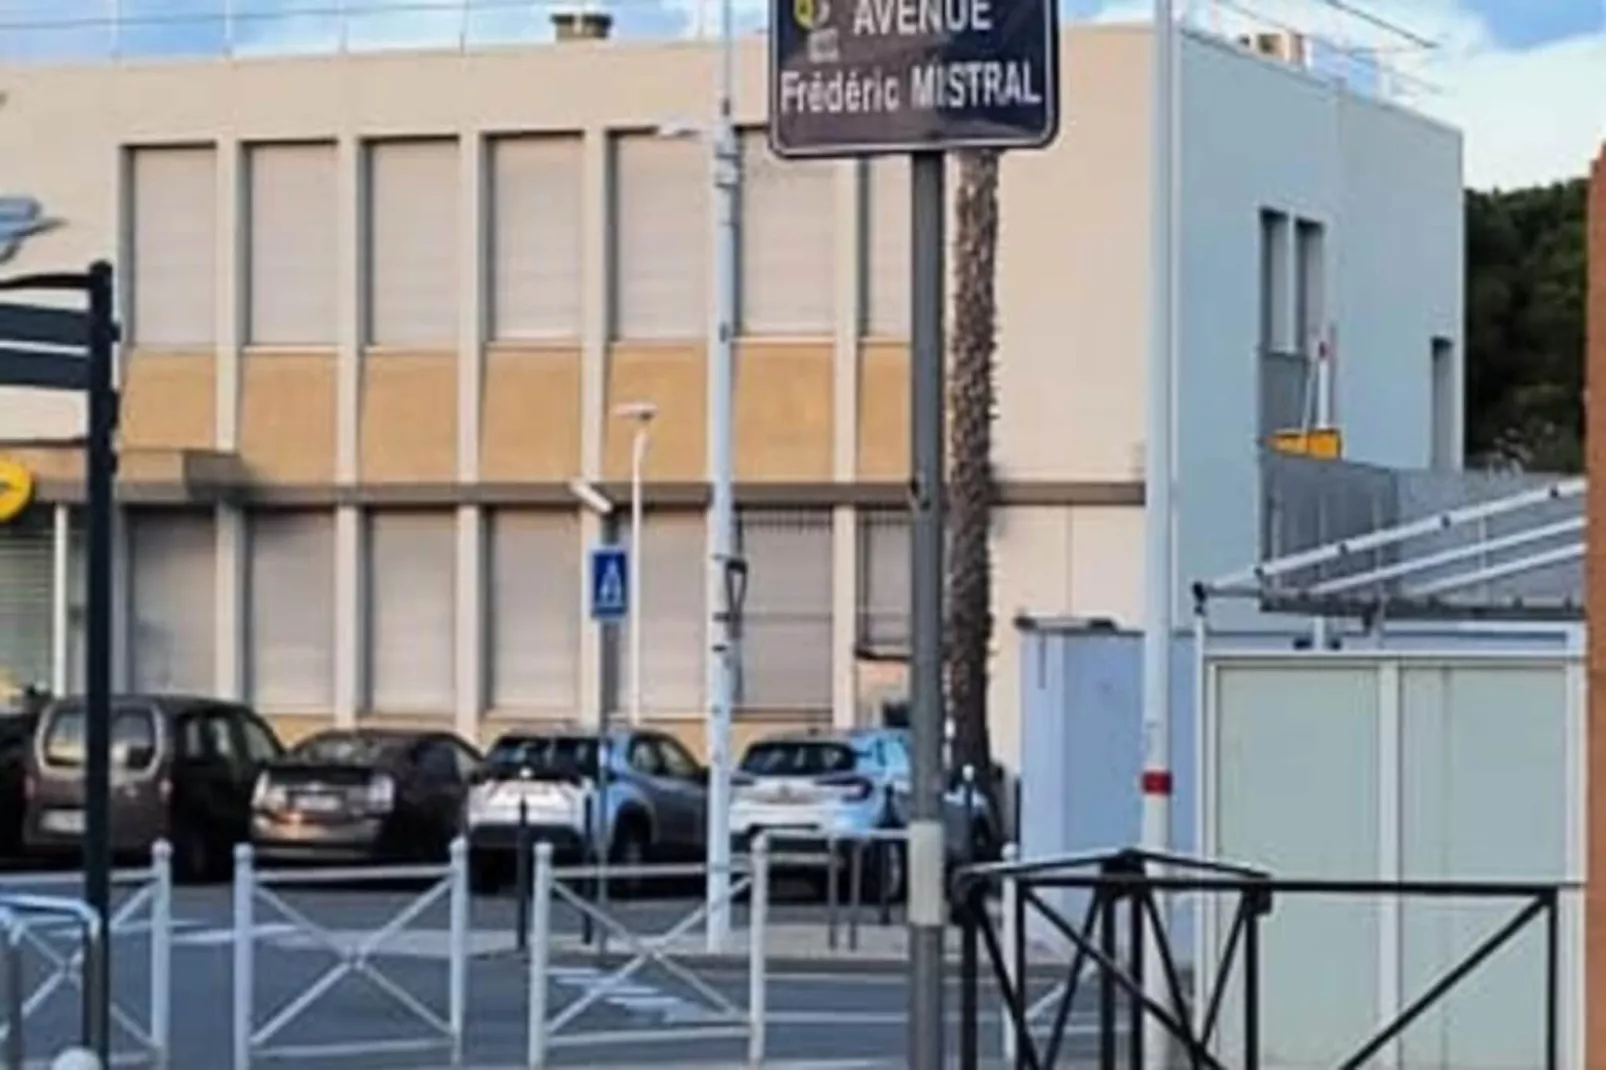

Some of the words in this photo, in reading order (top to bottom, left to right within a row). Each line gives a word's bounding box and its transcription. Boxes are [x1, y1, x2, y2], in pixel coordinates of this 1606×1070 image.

[853, 0, 992, 35] AVENUE
[781, 69, 899, 114] Frédéric
[911, 61, 1041, 110] MISTRAL
